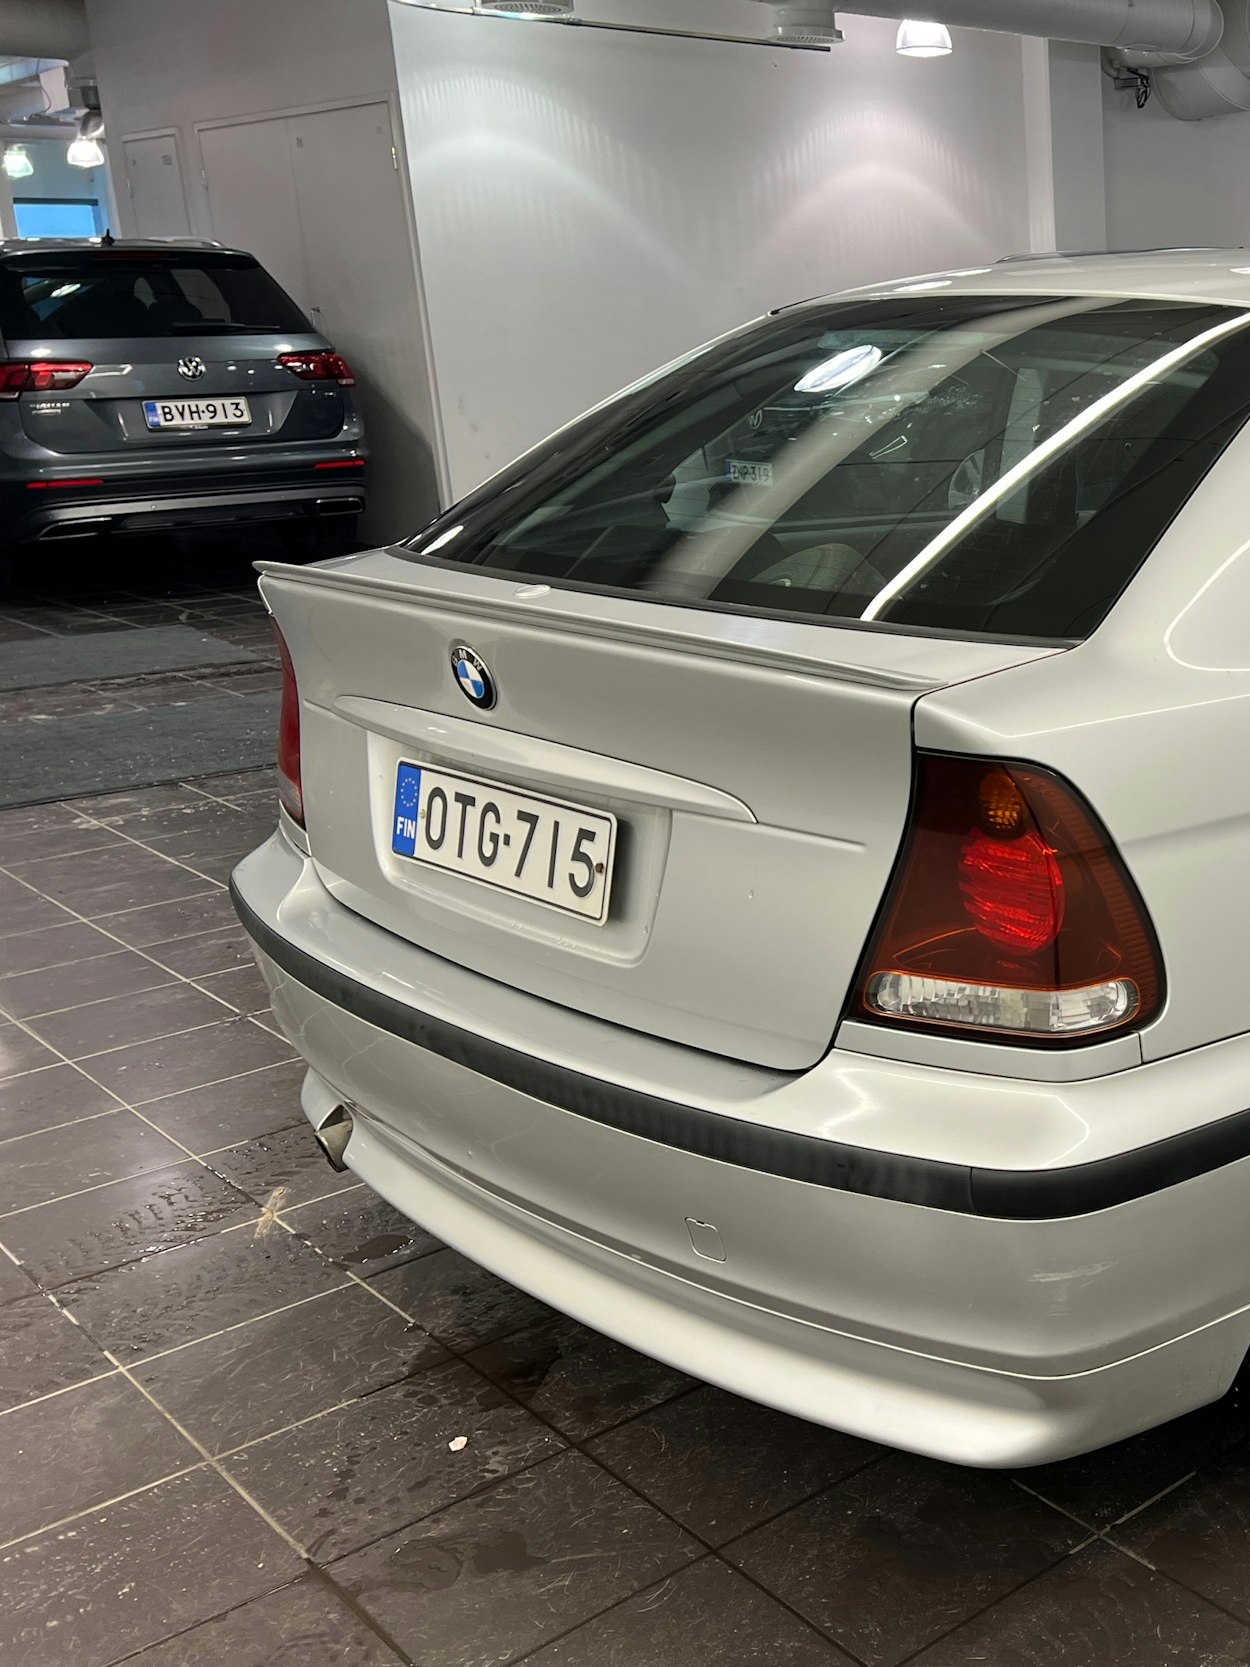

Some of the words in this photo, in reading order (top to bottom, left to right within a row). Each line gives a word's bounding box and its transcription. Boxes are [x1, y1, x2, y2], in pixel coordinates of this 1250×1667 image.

[161, 402, 244, 422] BVH-913
[451, 648, 483, 671] BMW
[396, 816, 416, 840] FIN
[424, 786, 596, 898] OTG-715
